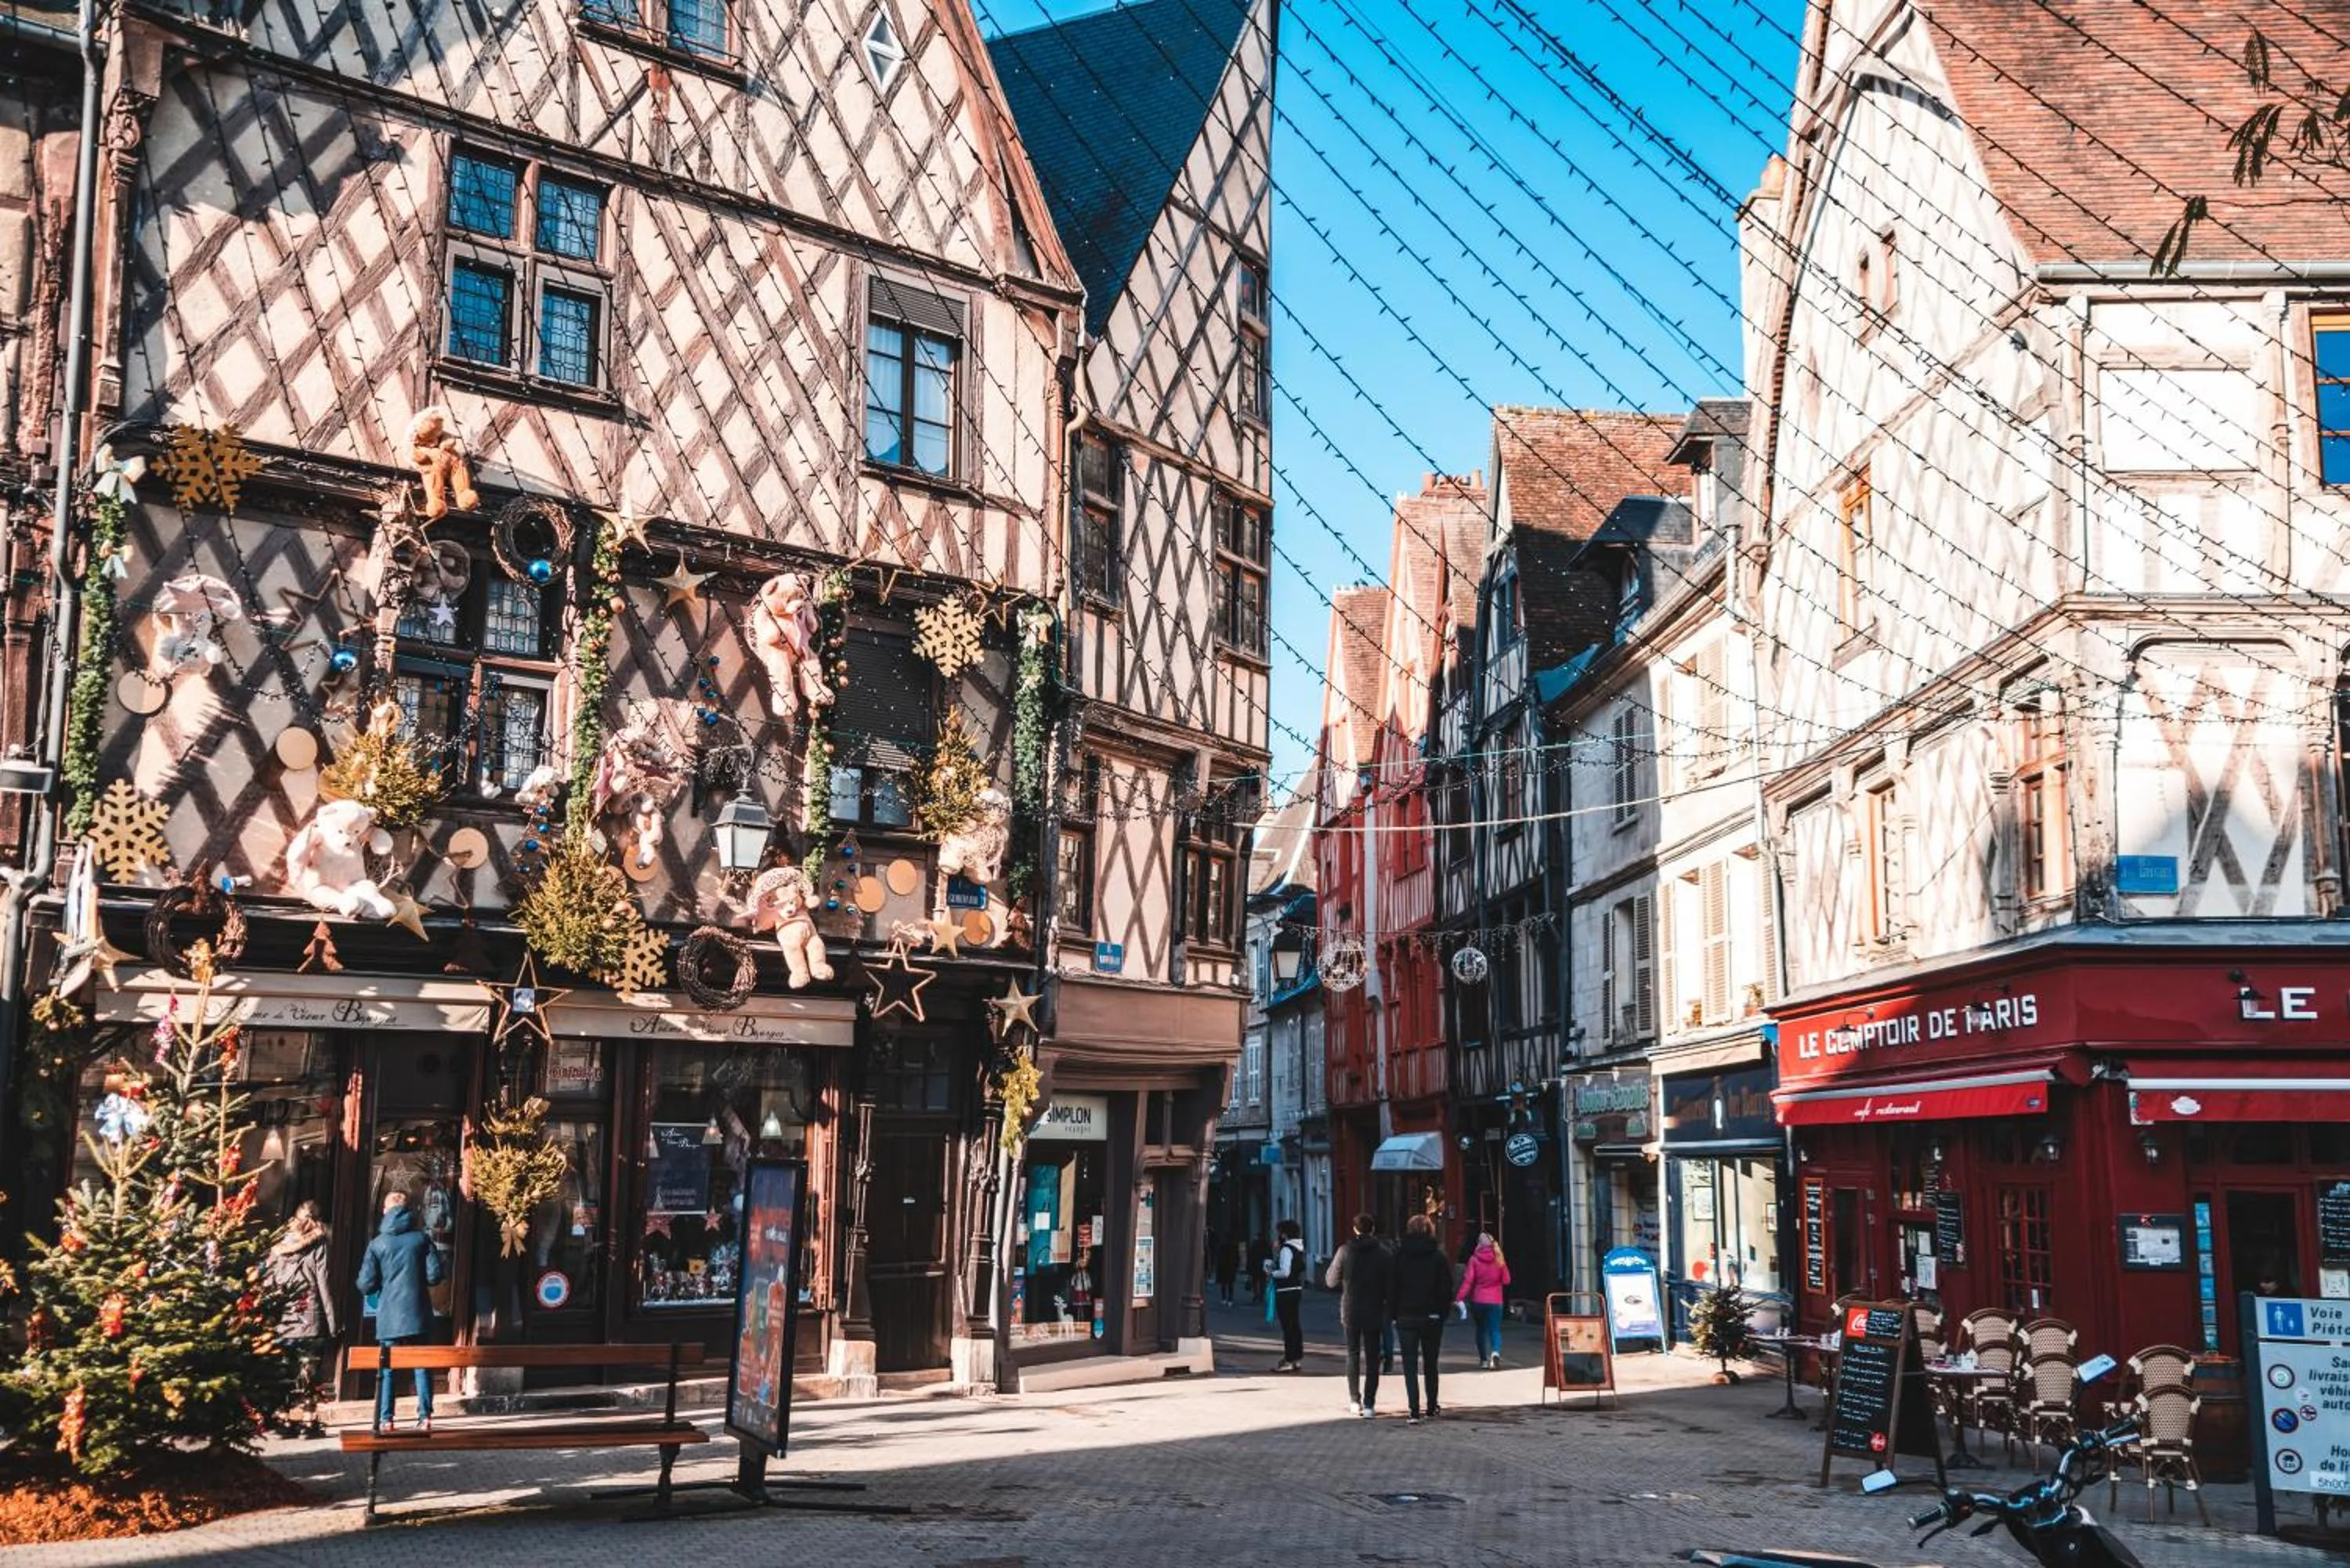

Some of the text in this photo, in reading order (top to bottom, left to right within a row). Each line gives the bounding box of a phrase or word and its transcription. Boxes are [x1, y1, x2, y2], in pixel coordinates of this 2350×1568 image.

[2239, 986, 2319, 1020] LE
[1799, 1031, 1820, 1058] LE
[1928, 1008, 1958, 1039] DE
[2310, 1306, 2343, 1320] Voie
[2319, 1384, 2350, 1396] véhi
[2319, 1459, 2350, 1472] de li
